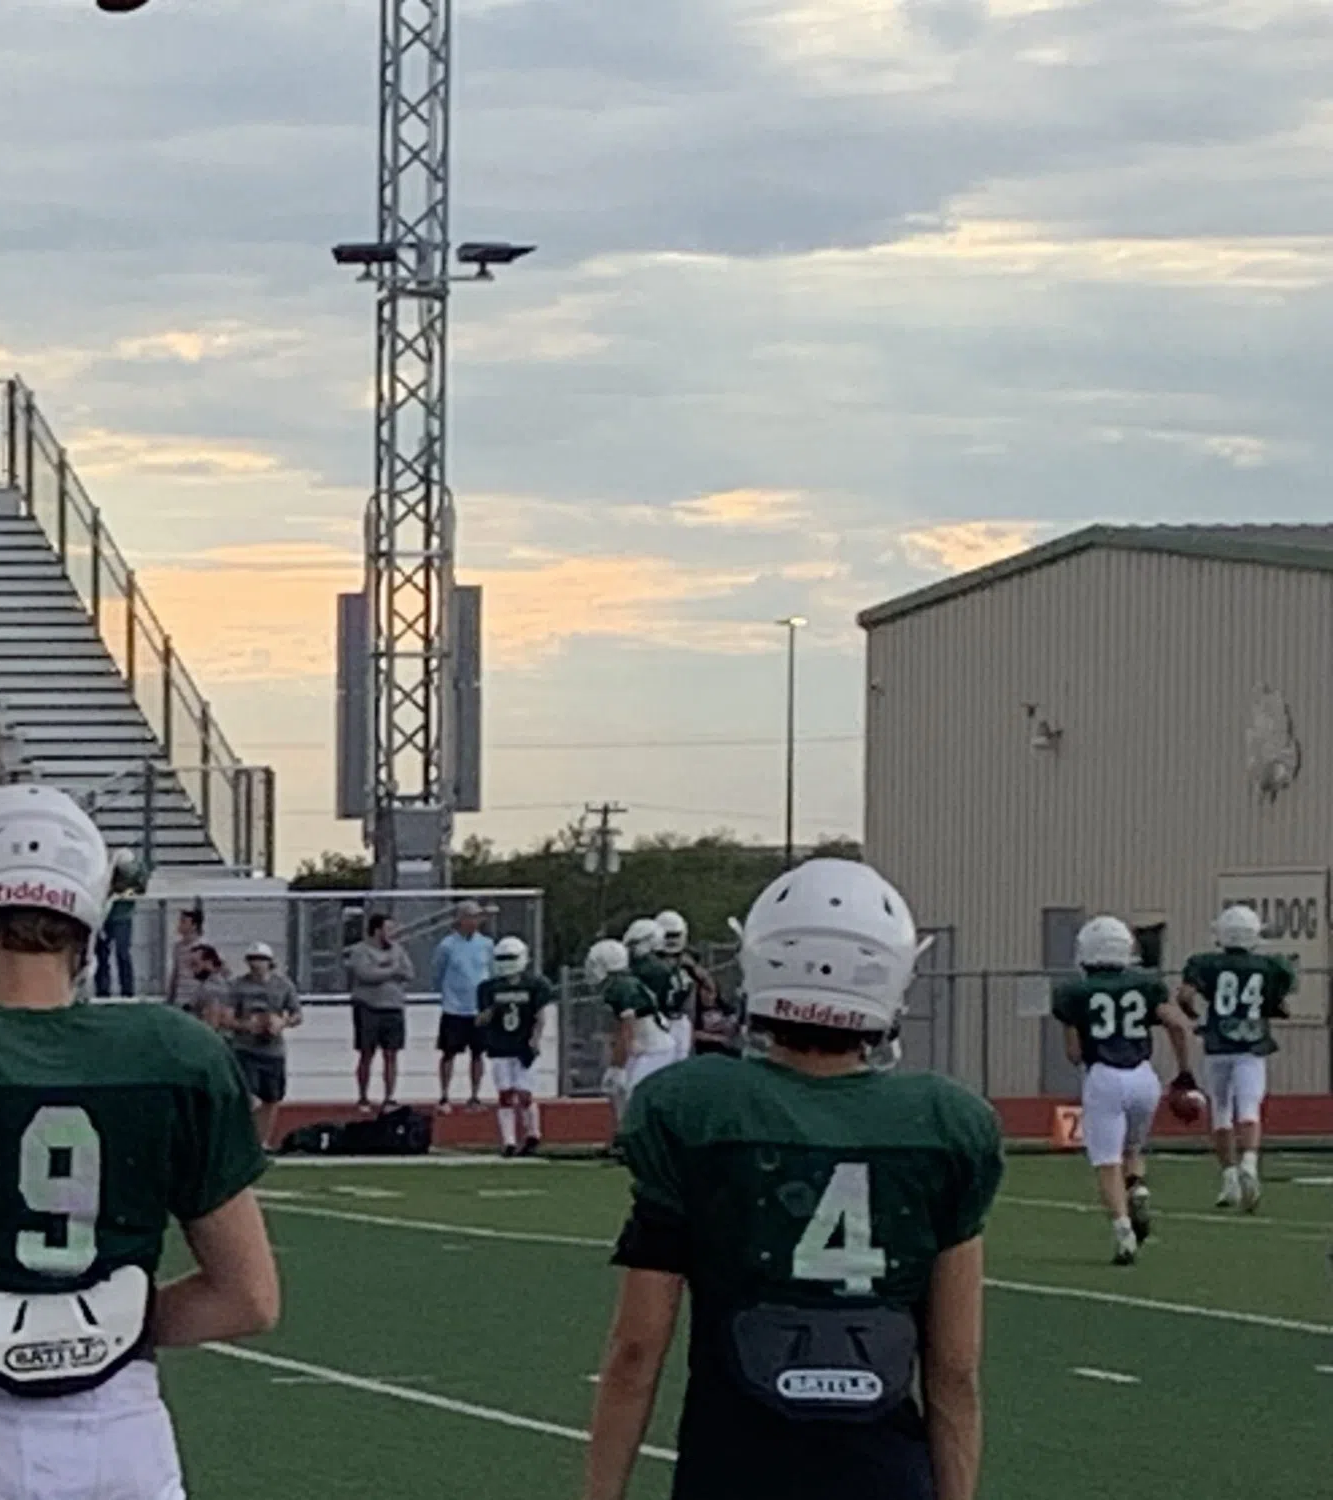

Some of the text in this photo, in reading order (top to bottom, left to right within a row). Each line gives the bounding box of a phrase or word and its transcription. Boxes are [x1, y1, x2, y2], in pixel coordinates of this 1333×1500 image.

[1222, 897, 1318, 939] LDOG
[775, 998, 865, 1028] Riddell
[1089, 990, 1148, 1040] 32
[1214, 970, 1264, 1020] 84
[15, 1105, 101, 1277] 9
[793, 1162, 886, 1297] 4
